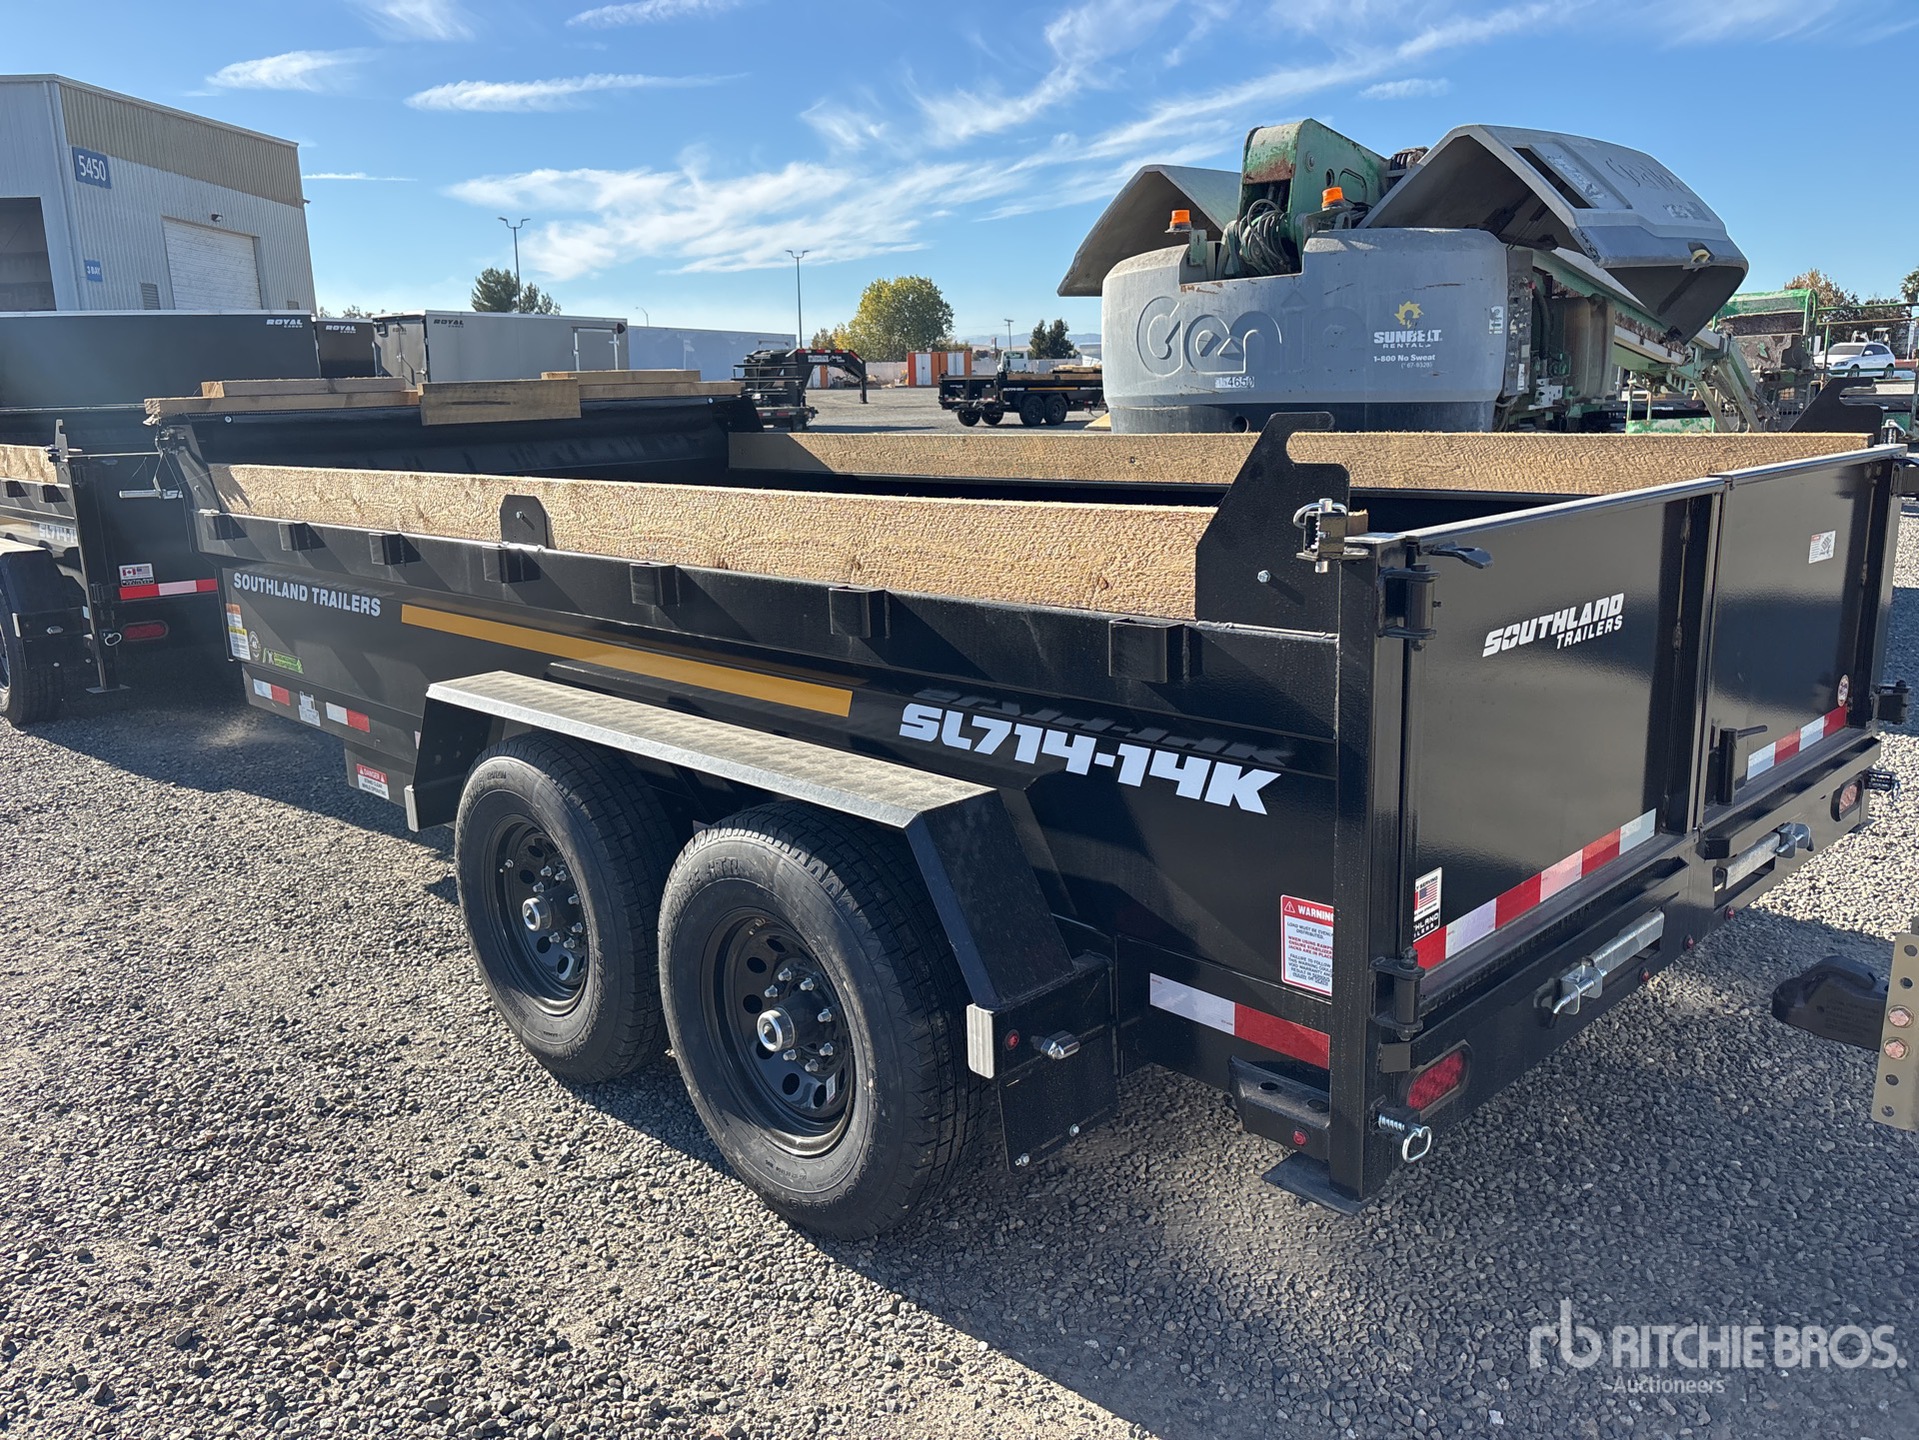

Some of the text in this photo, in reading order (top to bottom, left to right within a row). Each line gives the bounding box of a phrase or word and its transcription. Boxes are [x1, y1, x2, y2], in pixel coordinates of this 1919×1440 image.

[78, 155, 106, 182] 5450
[266, 318, 303, 326] ROYAL
[434, 318, 464, 326] ROYAL
[1373, 330, 1441, 344] SUNBELT
[1397, 354, 1409, 362] No
[1410, 354, 1436, 362] Sweat
[233, 572, 381, 617] SOUTHLAND TRAILERS
[1482, 592, 1625, 658] SOUTHLAND
[1556, 614, 1623, 650] TRAILERS
[899, 702, 1282, 816] SL714-14K
[1414, 913, 1439, 931] HLAND
